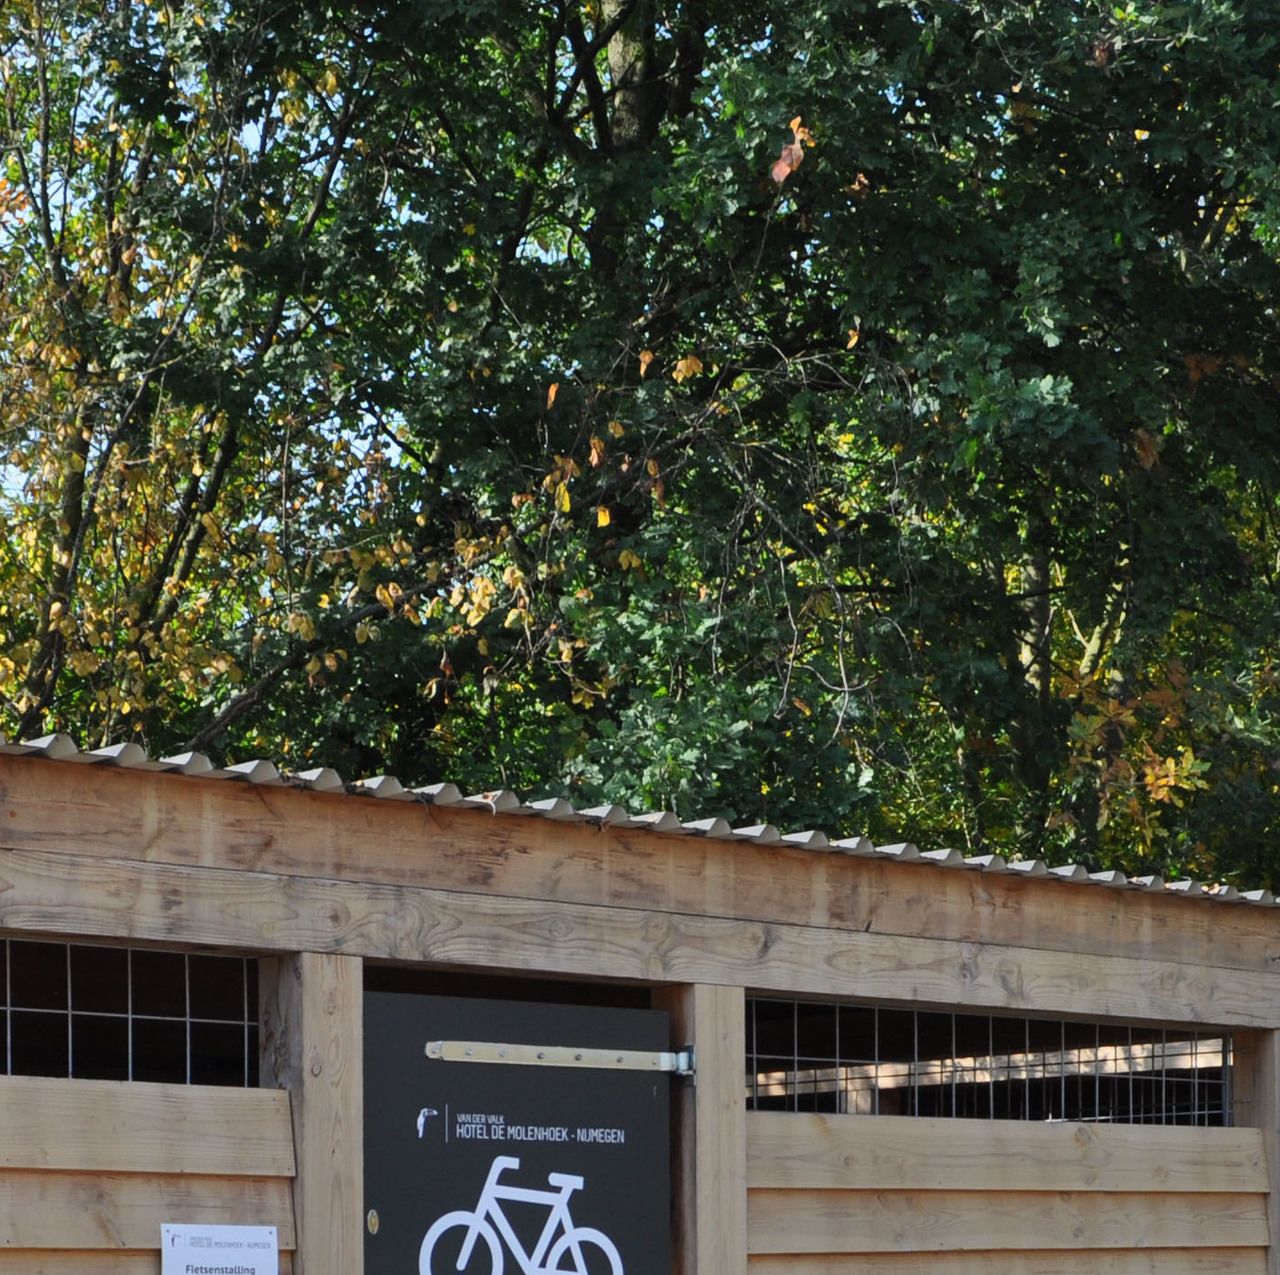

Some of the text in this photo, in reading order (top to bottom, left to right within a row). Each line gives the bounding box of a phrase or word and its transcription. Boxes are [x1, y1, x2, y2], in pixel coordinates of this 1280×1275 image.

[457, 1113, 505, 1125] VAN DER VALK
[456, 1124, 489, 1139] HOTEL
[491, 1125, 505, 1140] DE
[507, 1126, 568, 1142] MOLENHOEK
[576, 1128, 625, 1143] NIJMEGEN
